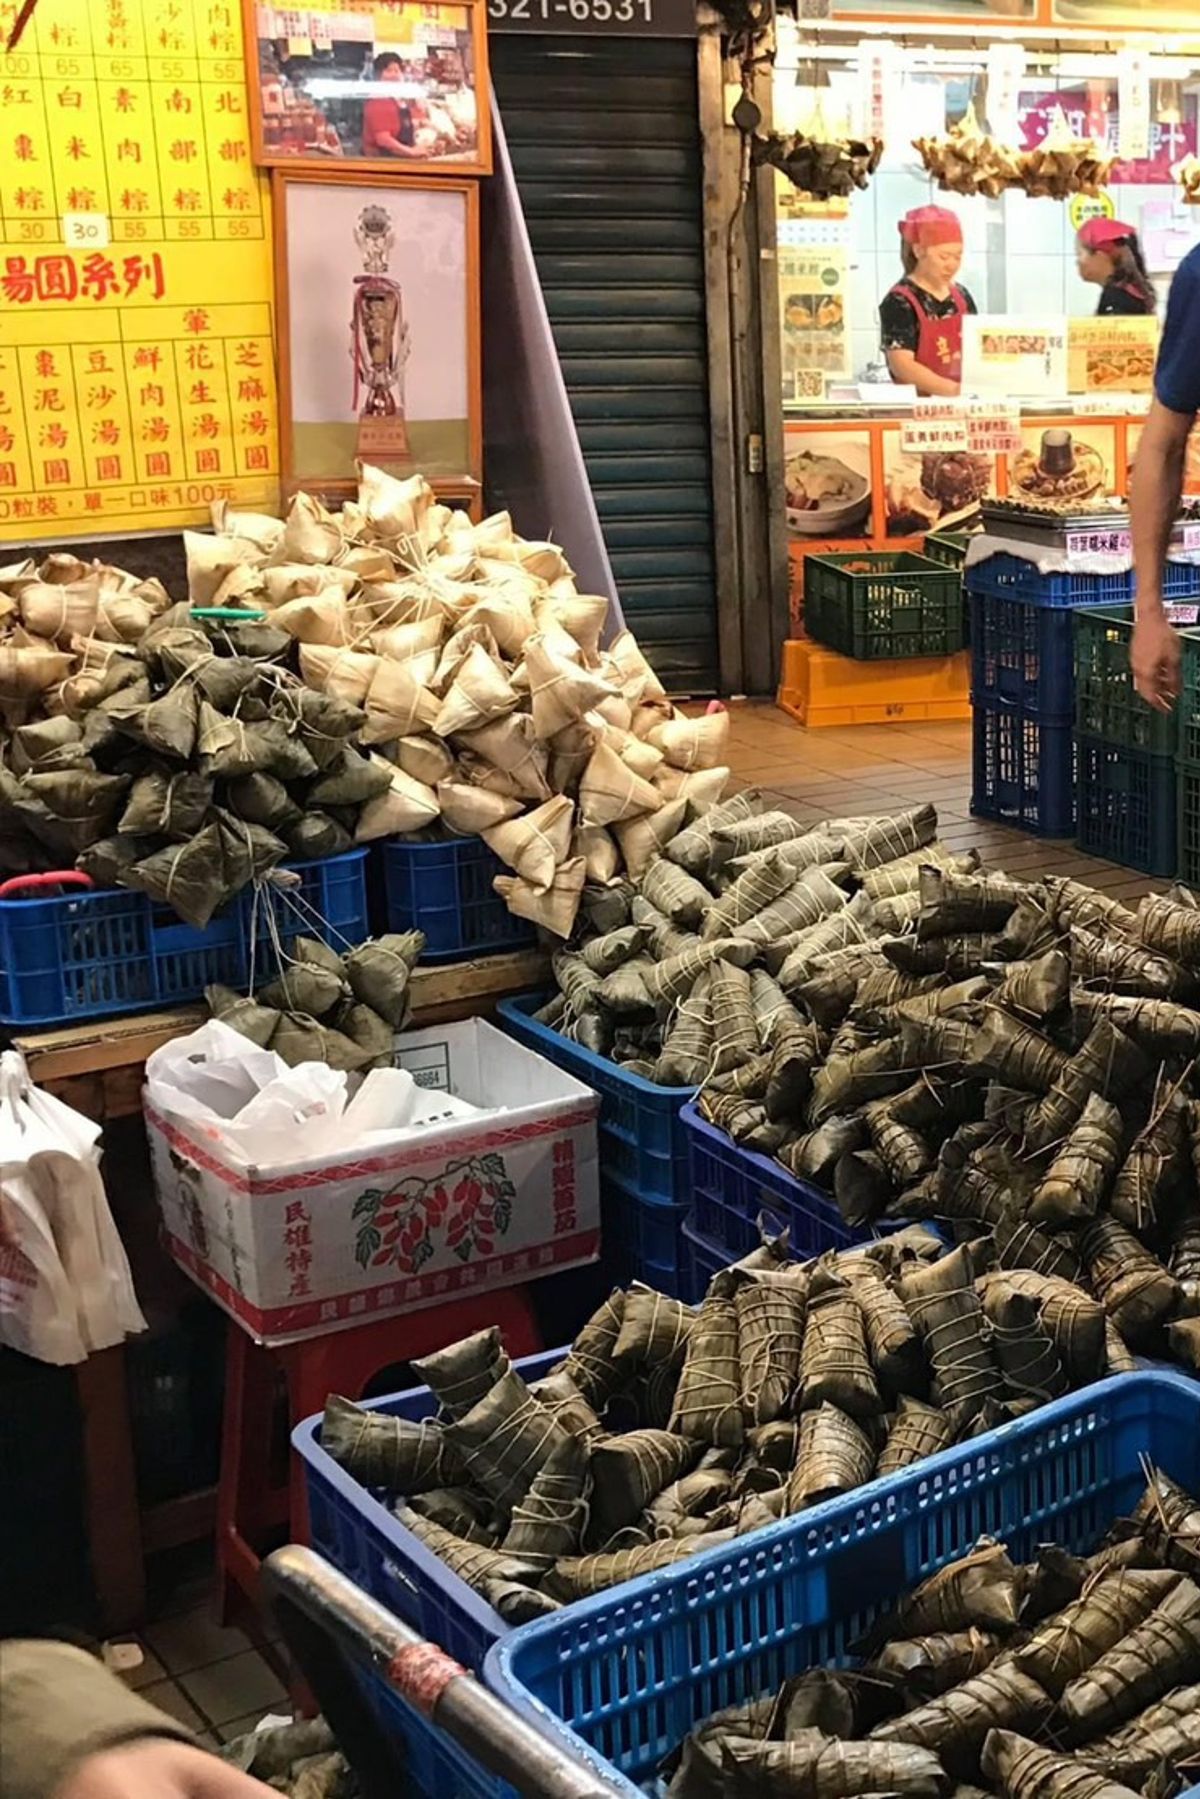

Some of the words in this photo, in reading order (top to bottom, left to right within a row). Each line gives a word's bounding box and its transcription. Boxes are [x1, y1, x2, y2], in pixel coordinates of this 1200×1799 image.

[56, 58, 80, 76] 65
[110, 60, 134, 77] 65
[161, 62, 185, 79] 55
[213, 63, 237, 80] 55
[20, 222, 45, 239] 30
[72, 223, 99, 239] 30
[123, 221, 147, 238] 55
[178, 221, 201, 237] 55
[227, 220, 251, 236] 55
[132, 346, 171, 478] 鮮肉湯圓
[185, 342, 222, 474] 花生湯圓
[234, 341, 270, 471] 芝麻湯圓
[34, 349, 71, 485] 棗泥湯圓
[84, 349, 122, 482] 豆沙湯圓
[283, 1200, 313, 1298] 民雄特產
